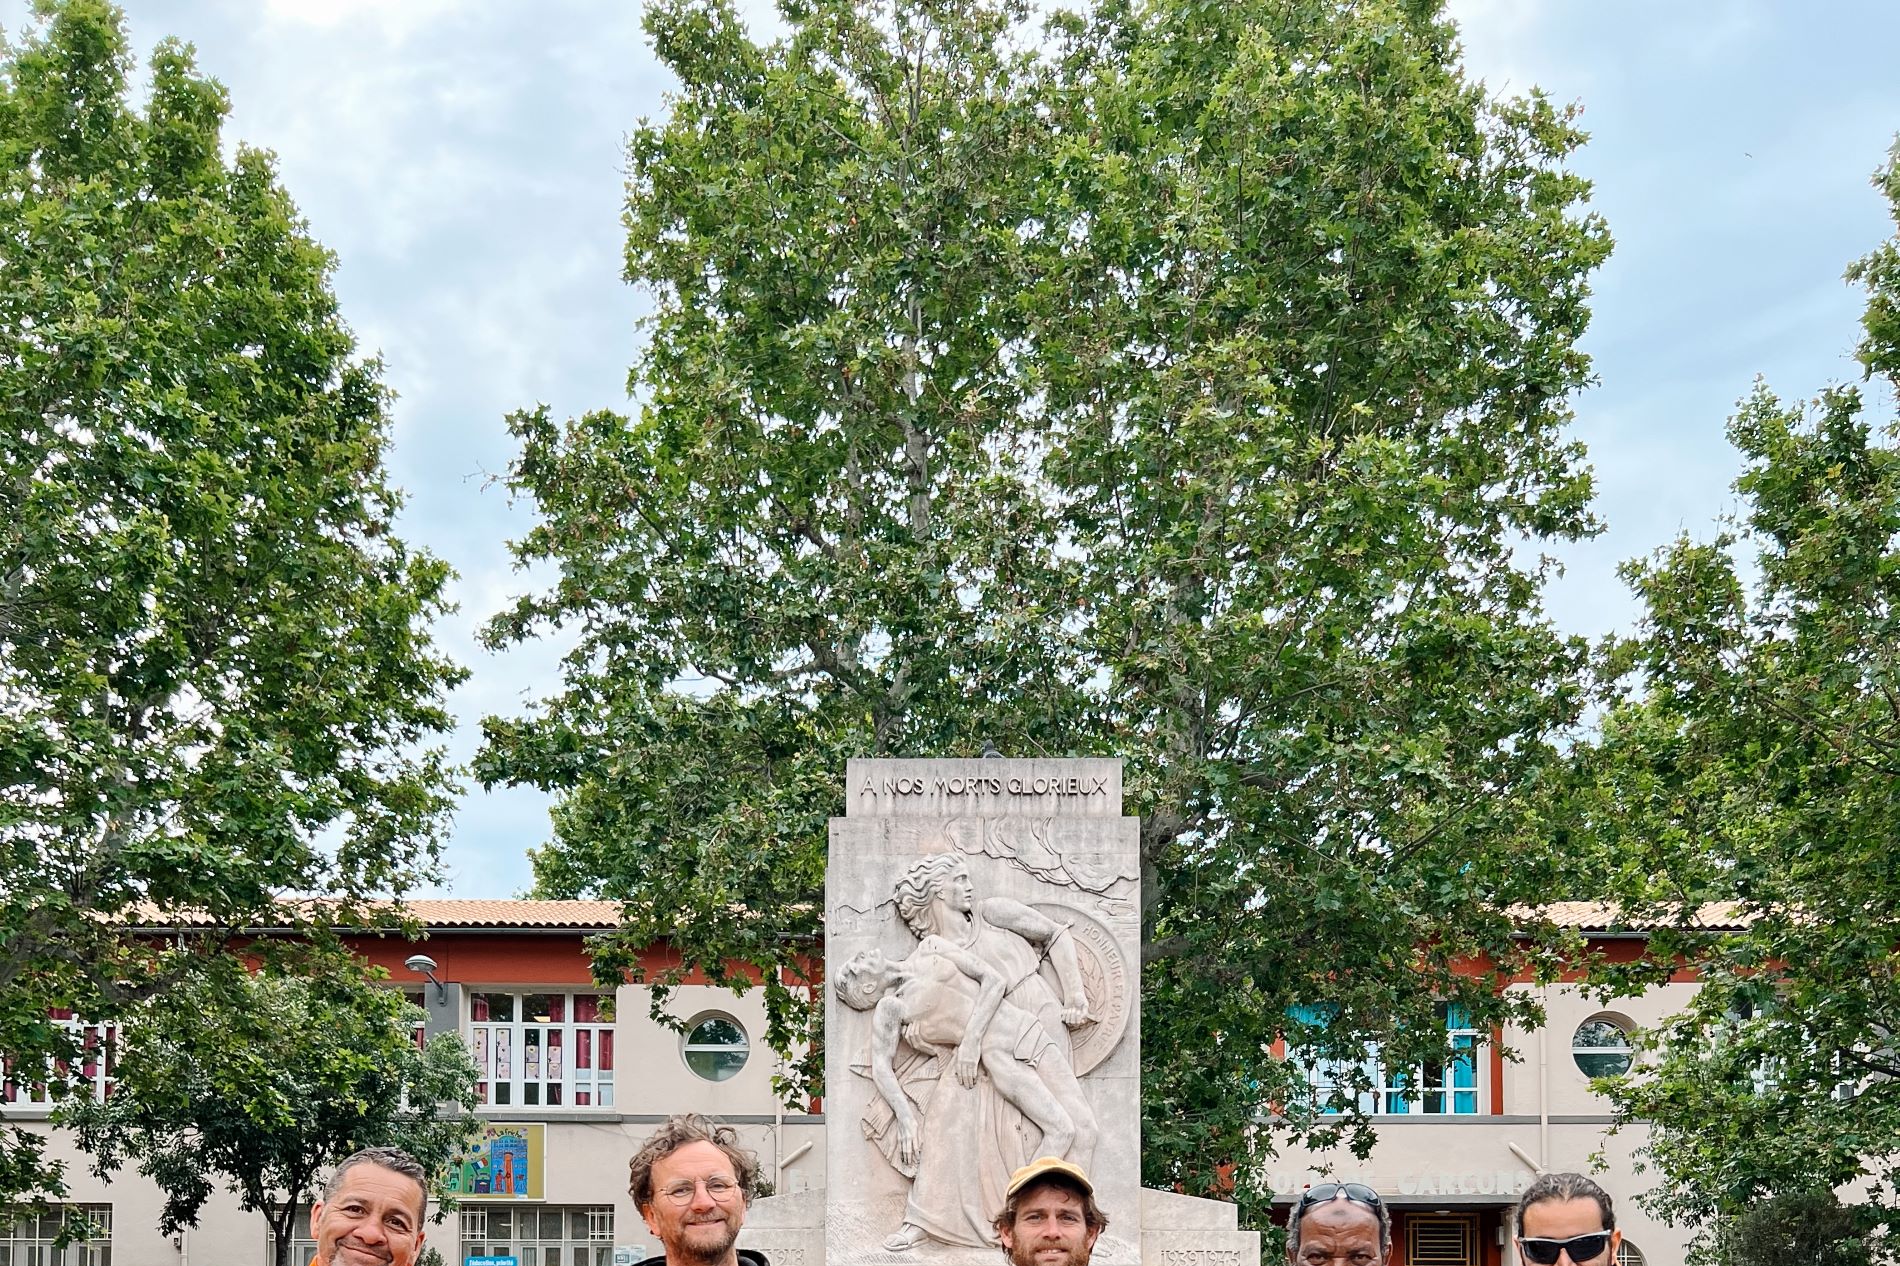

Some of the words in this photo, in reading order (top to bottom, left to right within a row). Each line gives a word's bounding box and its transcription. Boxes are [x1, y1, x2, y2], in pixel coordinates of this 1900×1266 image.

[860, 776, 877, 796] A
[883, 777, 924, 796] NOS
[931, 777, 1000, 797] MORTS
[1007, 777, 1108, 796] GLORIEUX
